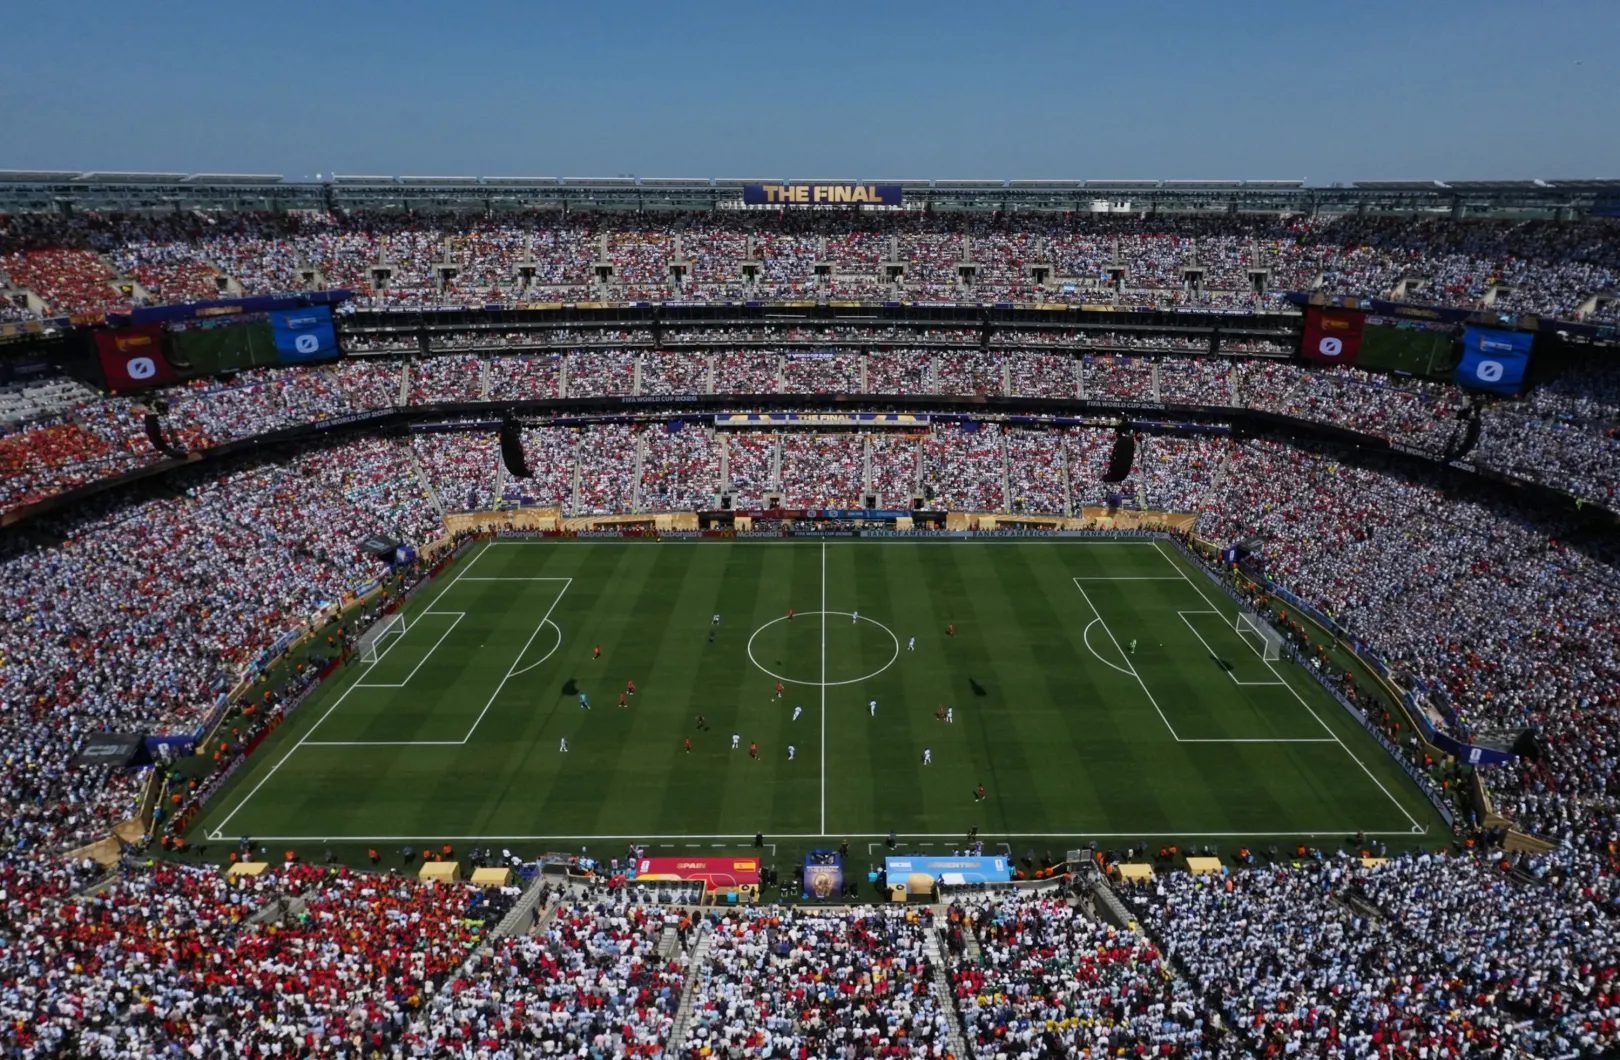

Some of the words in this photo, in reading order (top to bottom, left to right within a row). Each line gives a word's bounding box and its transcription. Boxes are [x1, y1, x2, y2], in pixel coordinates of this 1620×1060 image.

[763, 186, 810, 202] THE
[814, 186, 882, 202] FINAL
[315, 421, 331, 429] FIFA
[330, 416, 356, 425] WORLD
[357, 412, 371, 420] CUP
[1406, 447, 1433, 459] WORLD
[1365, 719, 1386, 742] BANK
[1400, 756, 1437, 799] AMERICA
[199, 752, 246, 808] McDonald's
